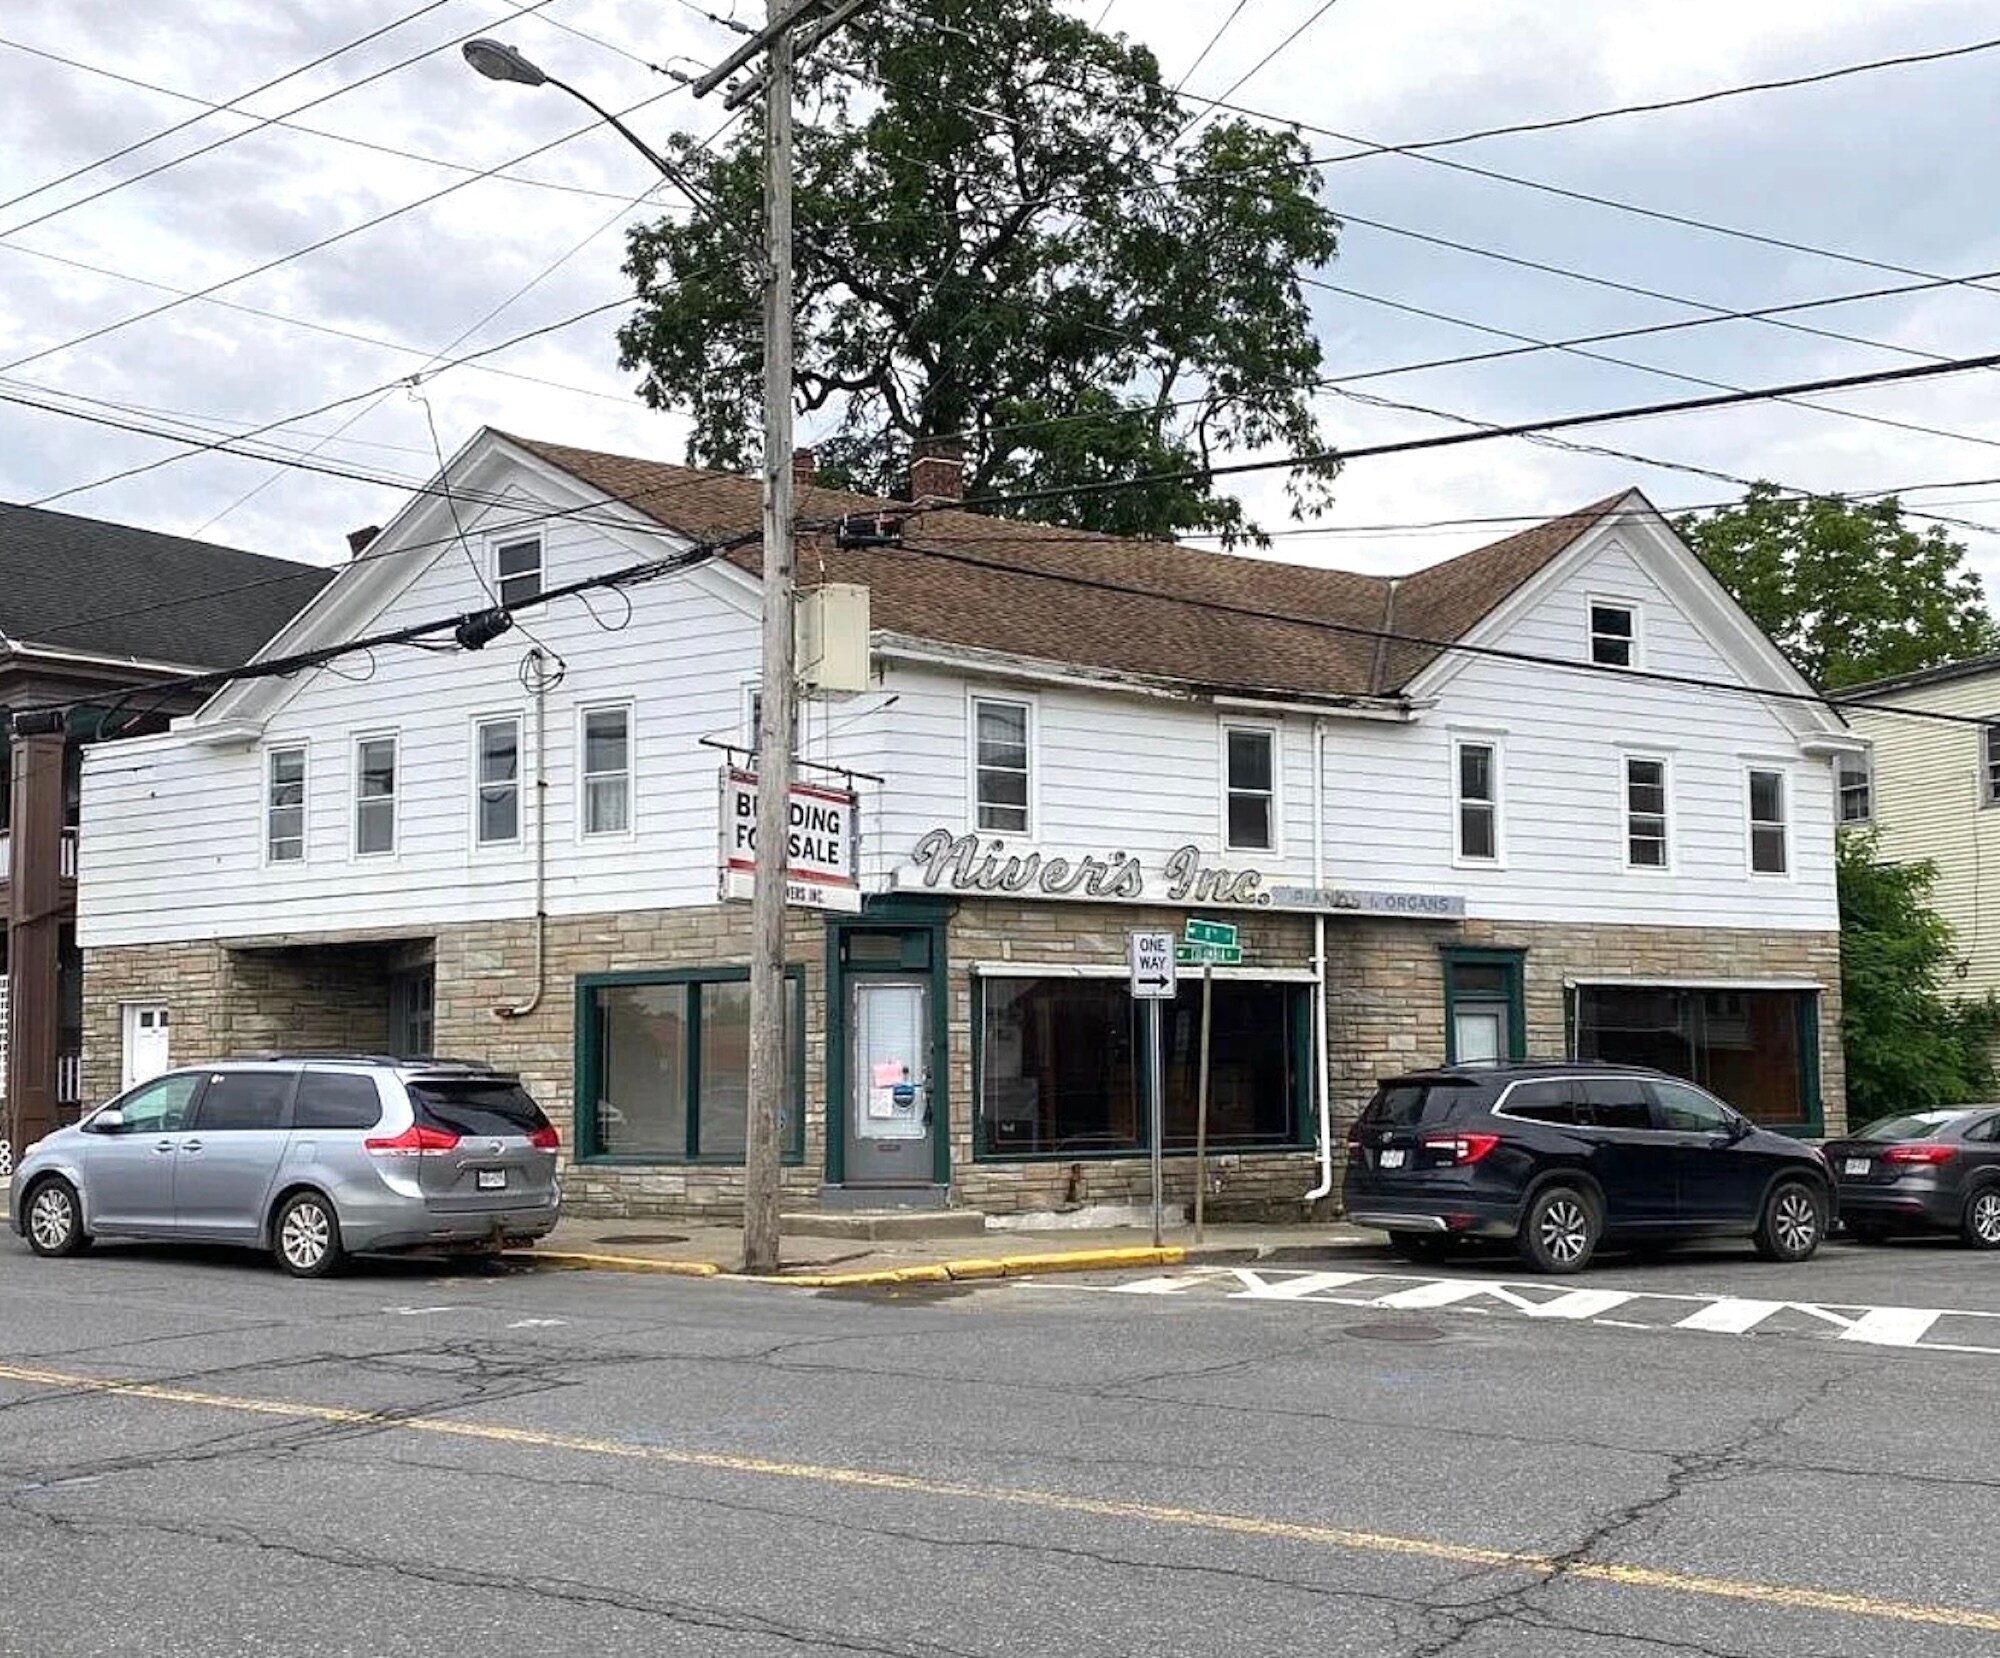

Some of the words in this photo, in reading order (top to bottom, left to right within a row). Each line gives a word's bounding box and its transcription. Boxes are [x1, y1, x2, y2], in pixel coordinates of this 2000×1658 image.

[737, 793, 839, 834] BDING
[789, 834, 839, 864] SALE
[912, 828, 1142, 898] Niver's
[1163, 844, 1270, 906] Inc.
[1385, 896, 1449, 912] ORGANS
[1140, 938, 1166, 952] ONE
[1140, 956, 1167, 970] WAY
